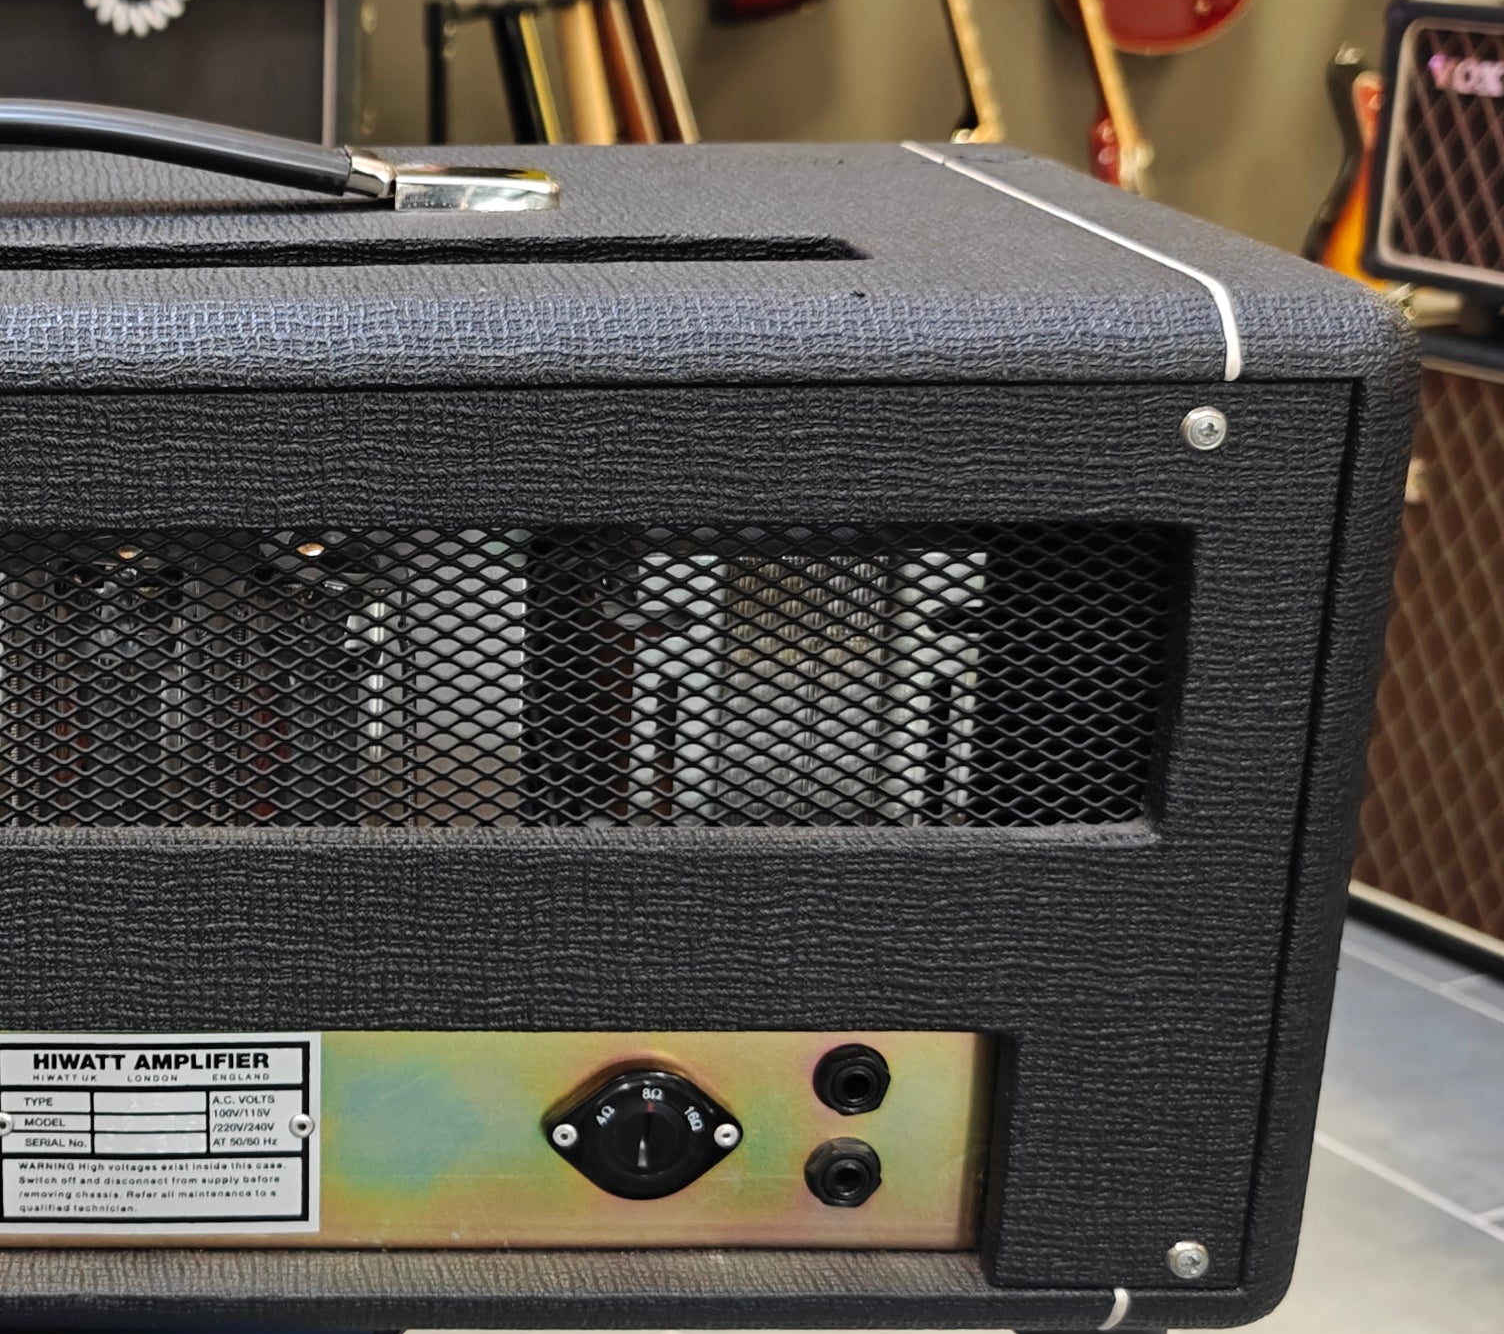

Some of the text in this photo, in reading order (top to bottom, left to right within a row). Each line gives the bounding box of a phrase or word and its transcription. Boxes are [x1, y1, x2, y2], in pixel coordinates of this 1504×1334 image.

[33, 1052, 270, 1071] HIWATT AMPLIFIER
[32, 1073, 270, 1083] HIWATT UK LONDON ENGLAND
[23, 1097, 54, 1107] TYPE
[212, 1094, 275, 1105] A.C. VOLTS
[213, 1108, 271, 1118] 100V/115V
[23, 1117, 66, 1127] MODEL
[211, 1122, 275, 1133] /220V/240V
[24, 1137, 66, 1147] SERIAL
[212, 1137, 226, 1146] AT
[263, 1136, 278, 1146] Hz
[18, 1162, 75, 1170] WARNING
[78, 1162, 104, 1173] High
[108, 1163, 158, 1173] voltages
[161, 1162, 189, 1171] exist
[192, 1161, 228, 1170] inside
[231, 1161, 253, 1170] this
[18, 1175, 58, 1184] Switch
[61, 1175, 77, 1184] off
[80, 1175, 100, 1184] and
[103, 1175, 168, 1186] disconnect
[171, 1175, 198, 1185] from
[201, 1175, 239, 1185] supply
[19, 1191, 72, 1200] removing
[126, 1190, 158, 1199] Refer
[161, 1189, 175, 1199] all
[178, 1189, 252, 1199] maintenance
[255, 1189, 267, 1198] to
[270, 1190, 277, 1198] a
[19, 1204, 71, 1213] qualified
